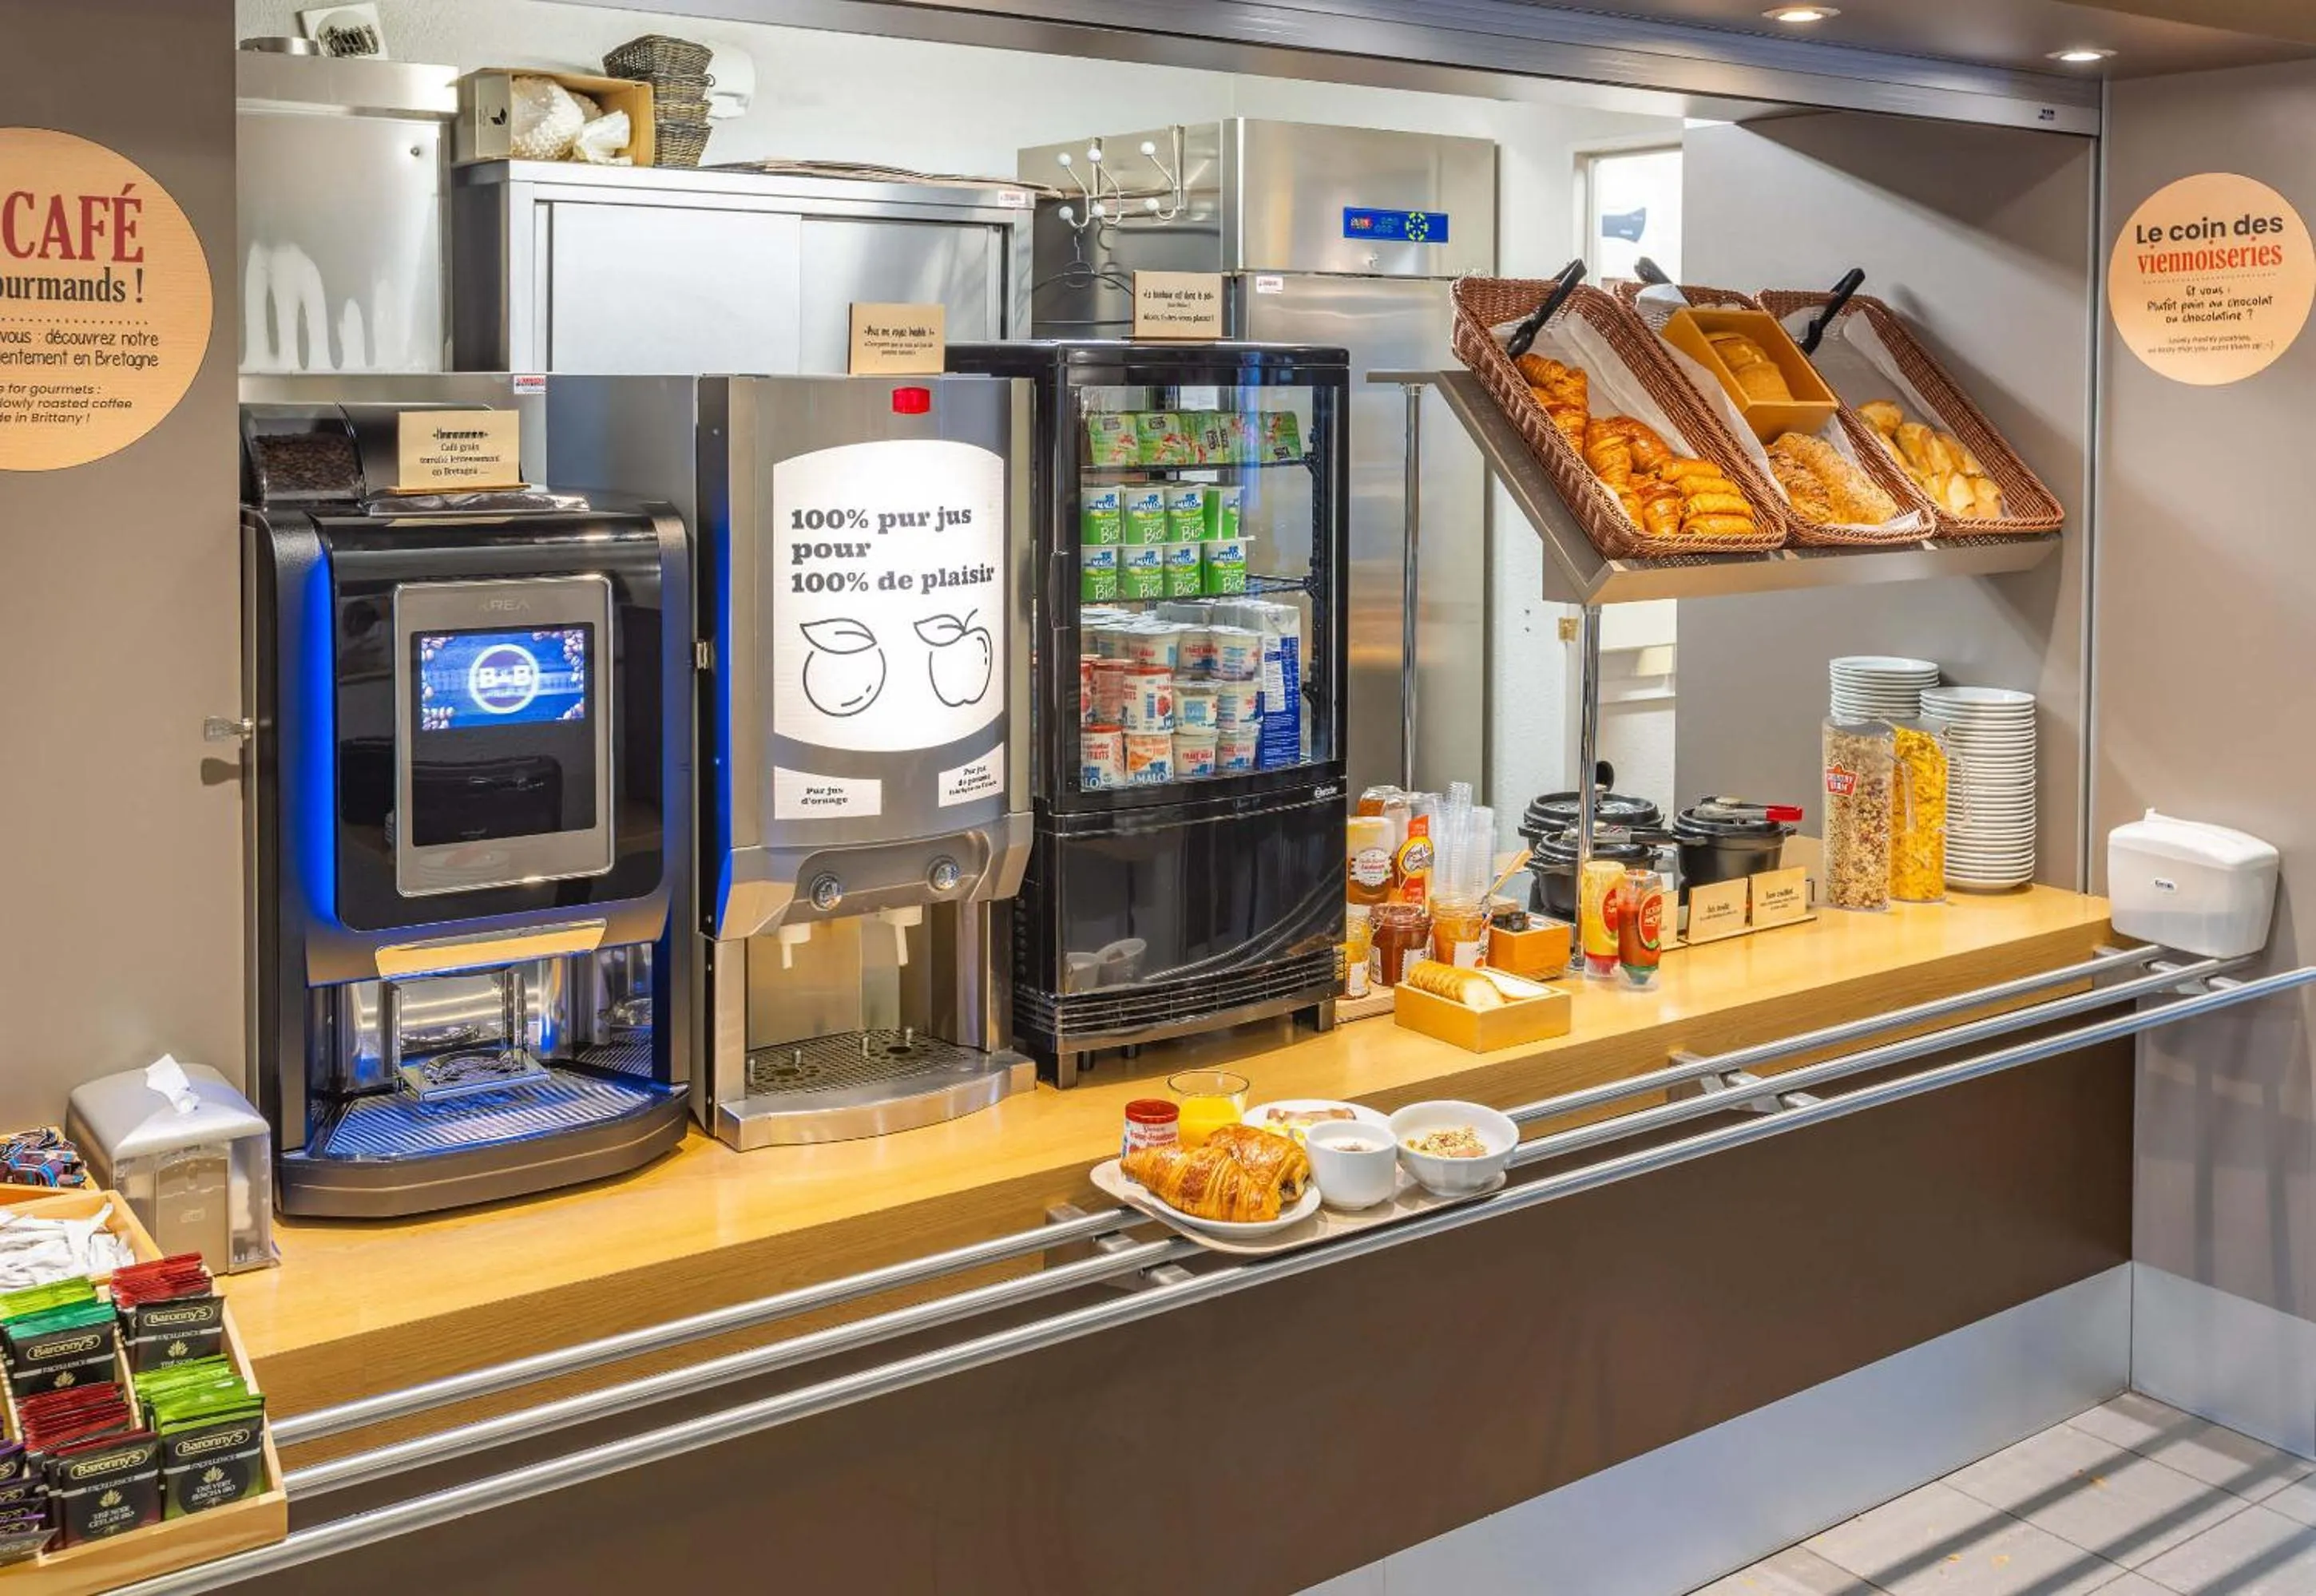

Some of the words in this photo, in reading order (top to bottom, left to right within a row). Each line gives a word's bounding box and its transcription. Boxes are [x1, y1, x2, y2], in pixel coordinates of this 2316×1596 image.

[2, 183, 145, 263] CAFÉ
[2136, 224, 2163, 244] Le
[2168, 216, 2227, 241] coin
[2233, 214, 2284, 236] des
[2137, 236, 2283, 275] viennoiseries
[2185, 285, 2196, 297] Et
[2199, 287, 2224, 296] vous
[2147, 297, 2177, 311] Plutôt
[2181, 300, 2204, 314] pain
[2227, 295, 2274, 309] chocolat
[2183, 311, 2242, 323] chocolatine
[45, 328, 116, 346] découvrez
[121, 331, 160, 347] notre
[0, 349, 68, 365] entement
[73, 353, 91, 366] en
[95, 350, 160, 370] Bretagne
[30, 384, 94, 398] gourmets
[38, 399, 89, 409] roasted
[92, 398, 133, 409] coffee
[14, 413, 27, 422] in
[31, 413, 83, 426] Brittany
[791, 509, 869, 530] 100%
[878, 511, 930, 535] pur
[934, 505, 972, 533] jus
[791, 542, 871, 565] pour
[791, 572, 869, 593] 100%
[878, 571, 914, 591] de
[921, 563, 995, 595] plaisir
[827, 786, 843, 795] jus
